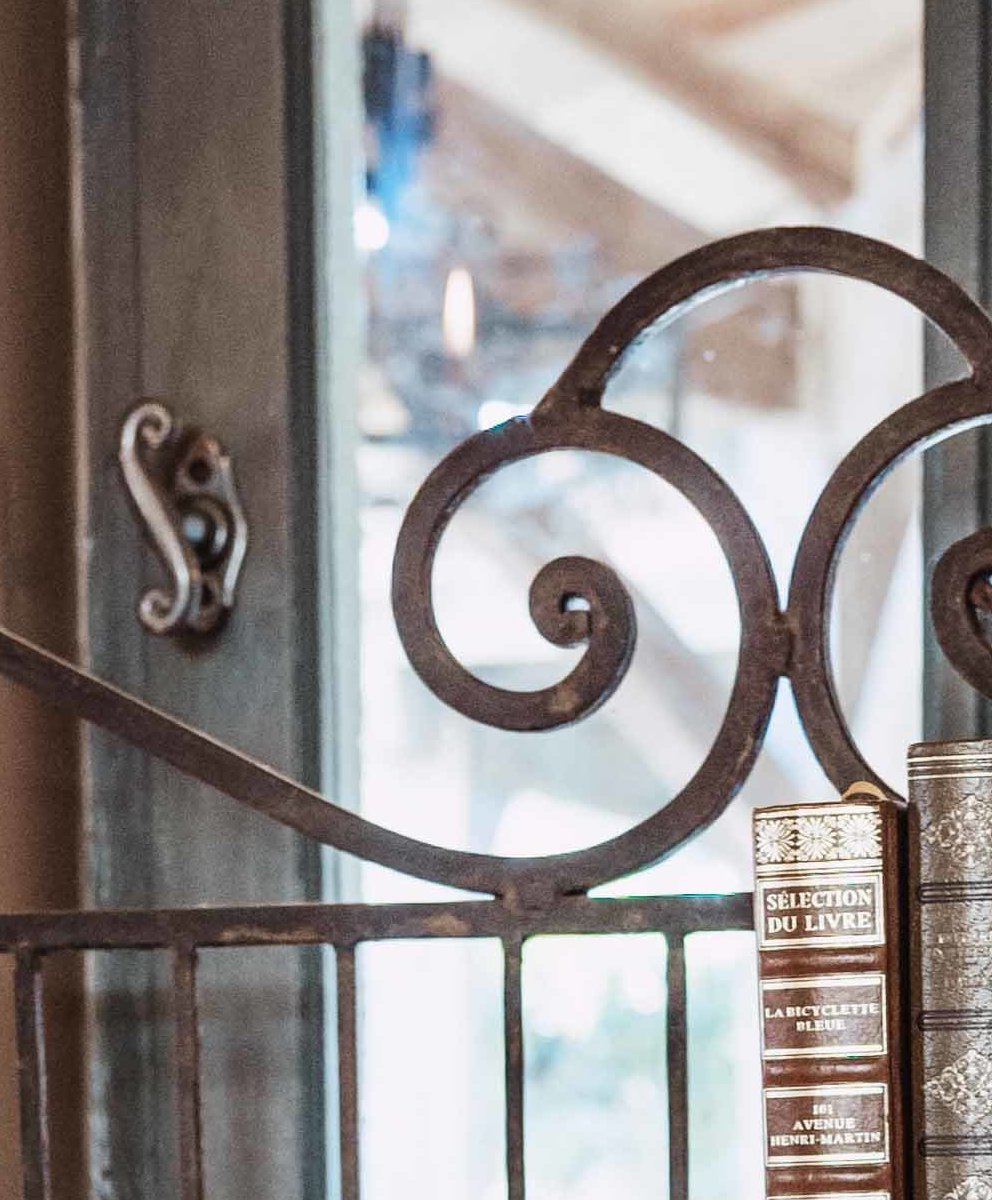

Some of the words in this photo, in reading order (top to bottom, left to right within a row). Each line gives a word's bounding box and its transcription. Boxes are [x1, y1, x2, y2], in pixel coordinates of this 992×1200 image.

[767, 915, 798, 934] DU
[804, 911, 872, 931] LIVRE
[796, 1018, 847, 1032] BLEUE
[792, 1118, 856, 1131] AVENUE
[770, 1131, 881, 1147] HENRI-MARTIN
